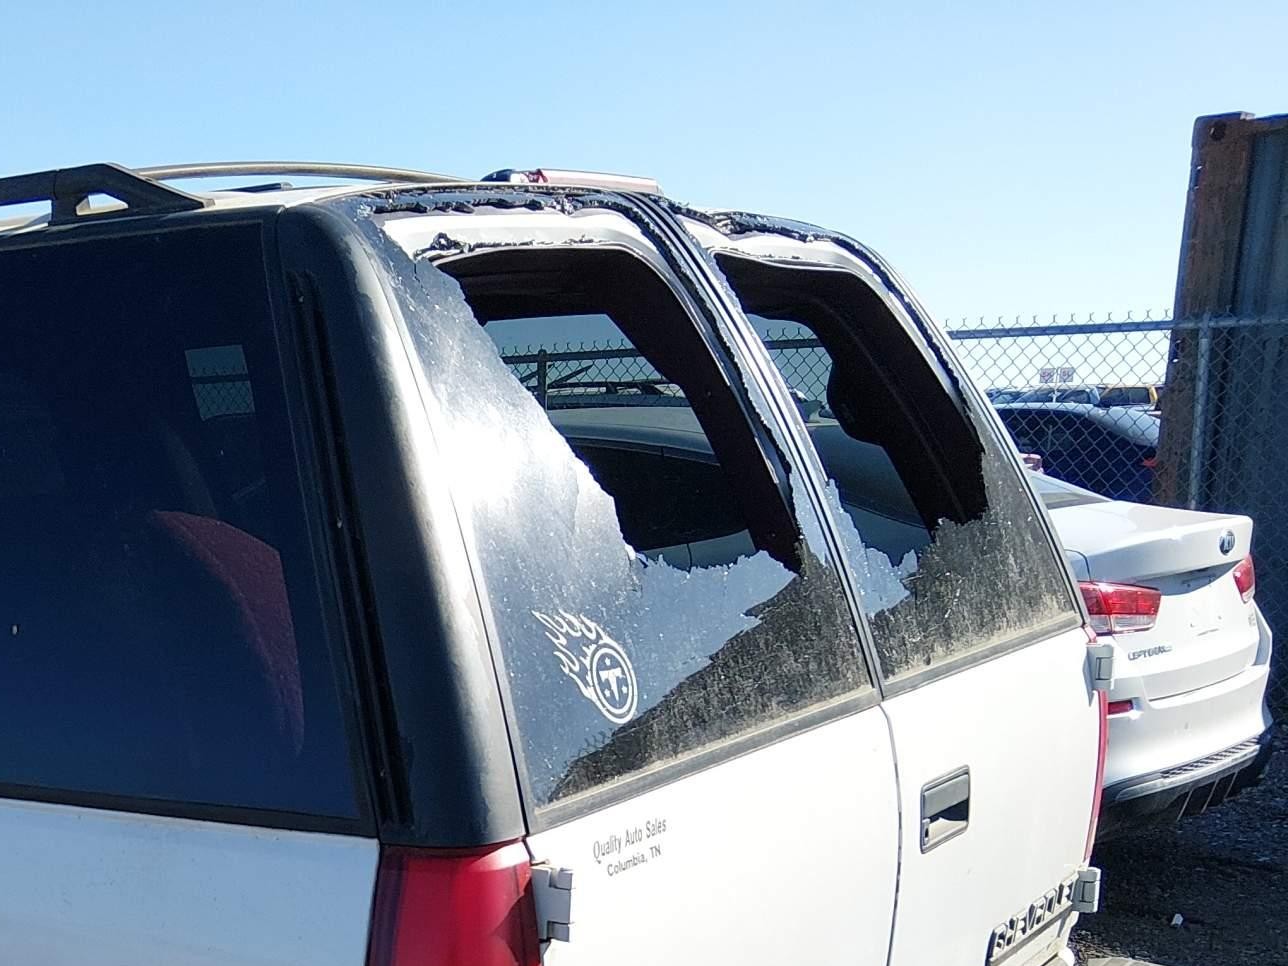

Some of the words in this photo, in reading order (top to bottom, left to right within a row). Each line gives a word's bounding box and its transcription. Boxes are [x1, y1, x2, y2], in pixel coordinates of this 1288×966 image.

[593, 835, 621, 864] Quality
[625, 827, 642, 847] Auto
[646, 818, 666, 838] Sales
[607, 853, 647, 876] Columbia,
[649, 844, 661, 858] TN
[986, 874, 1074, 962] CHEVROLE
